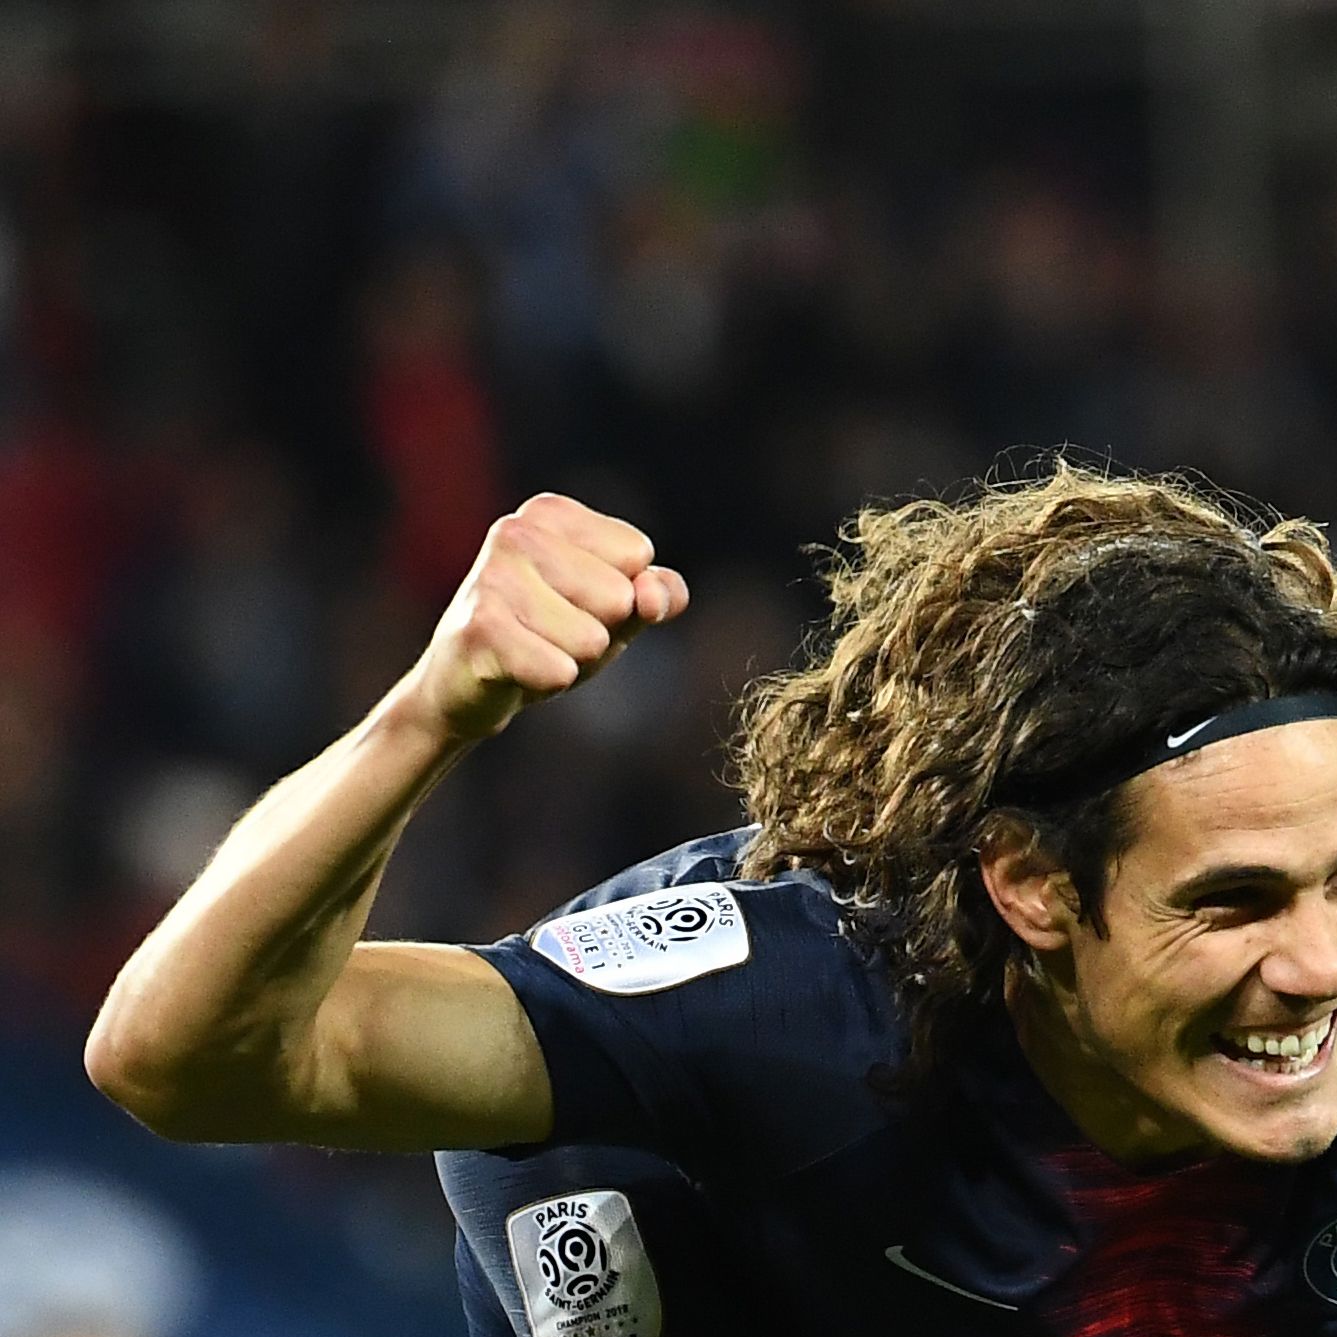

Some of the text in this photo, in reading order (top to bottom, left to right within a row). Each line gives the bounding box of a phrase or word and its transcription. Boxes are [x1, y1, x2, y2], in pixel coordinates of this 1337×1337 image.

[708, 890, 734, 927] PARIS
[535, 1201, 589, 1229] PARIS
[544, 1269, 620, 1311] SAINT-GERMAIN
[556, 1303, 629, 1331] CHAMPION 2018
